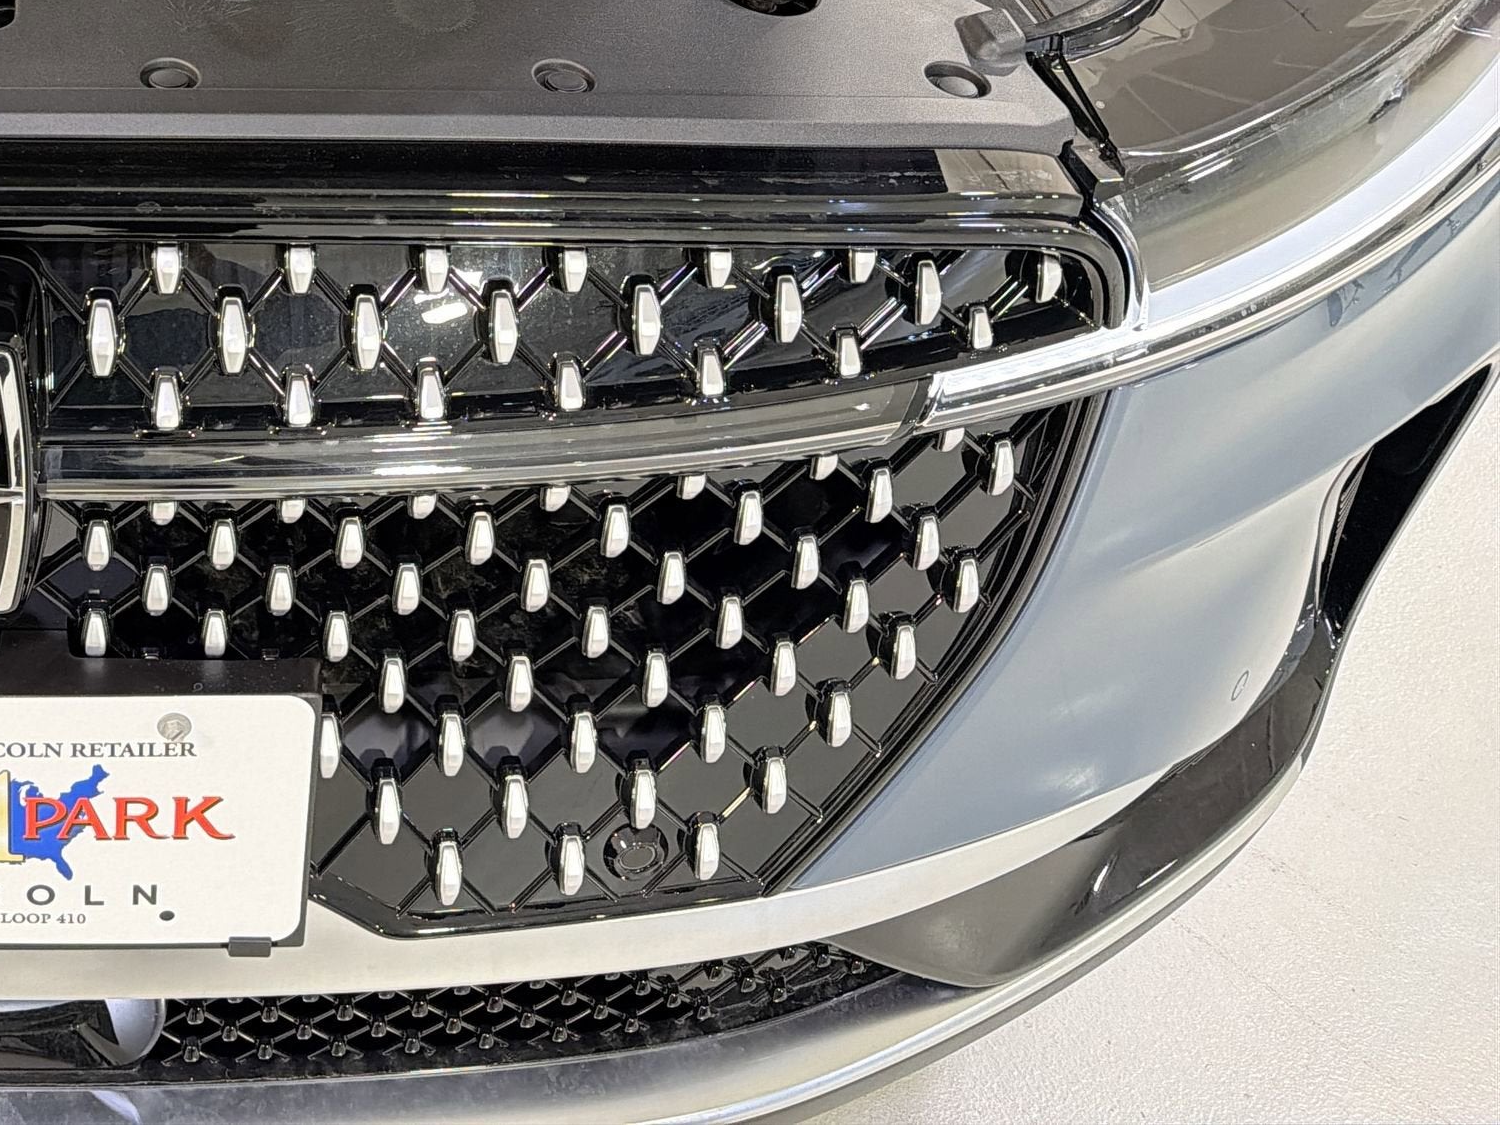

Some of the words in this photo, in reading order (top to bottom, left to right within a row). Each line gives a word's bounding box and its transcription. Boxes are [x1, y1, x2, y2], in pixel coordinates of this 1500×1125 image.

[70, 741, 198, 758] RETAILER
[22, 795, 236, 841] PARK
[1, 912, 52, 925] LOOP
[56, 912, 87, 925] 410
